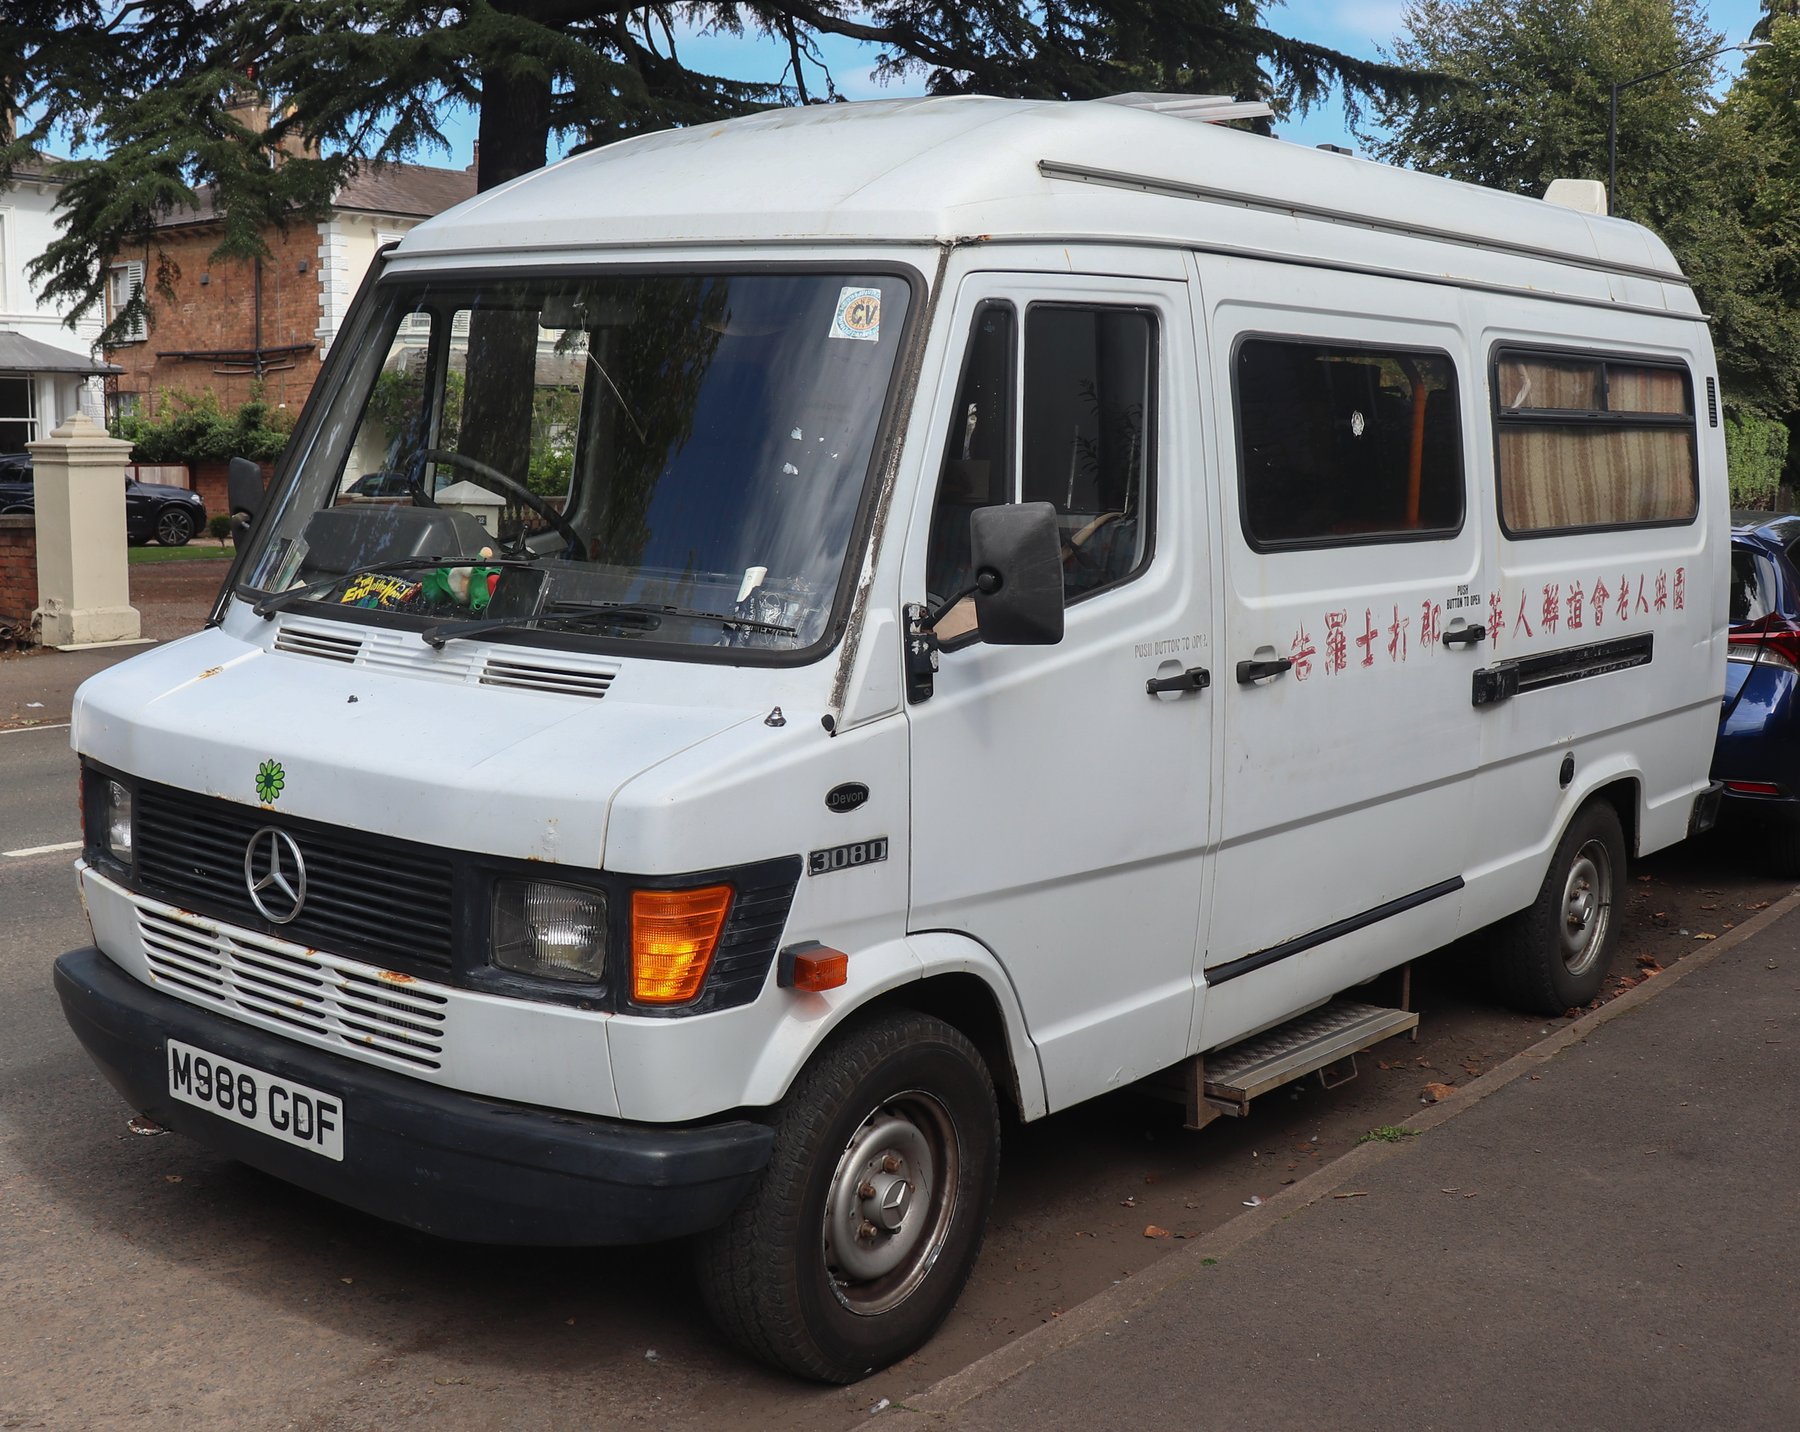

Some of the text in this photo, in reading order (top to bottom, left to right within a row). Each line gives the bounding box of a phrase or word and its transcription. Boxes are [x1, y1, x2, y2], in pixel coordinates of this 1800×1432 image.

[851, 303, 878, 325] CV
[341, 576, 375, 603] End
[1457, 584, 1469, 596] PUSH
[1446, 594, 1481, 610] BUTTON TO OPEN
[832, 791, 864, 805] Devon
[171, 1047, 338, 1145] M988 GDF
